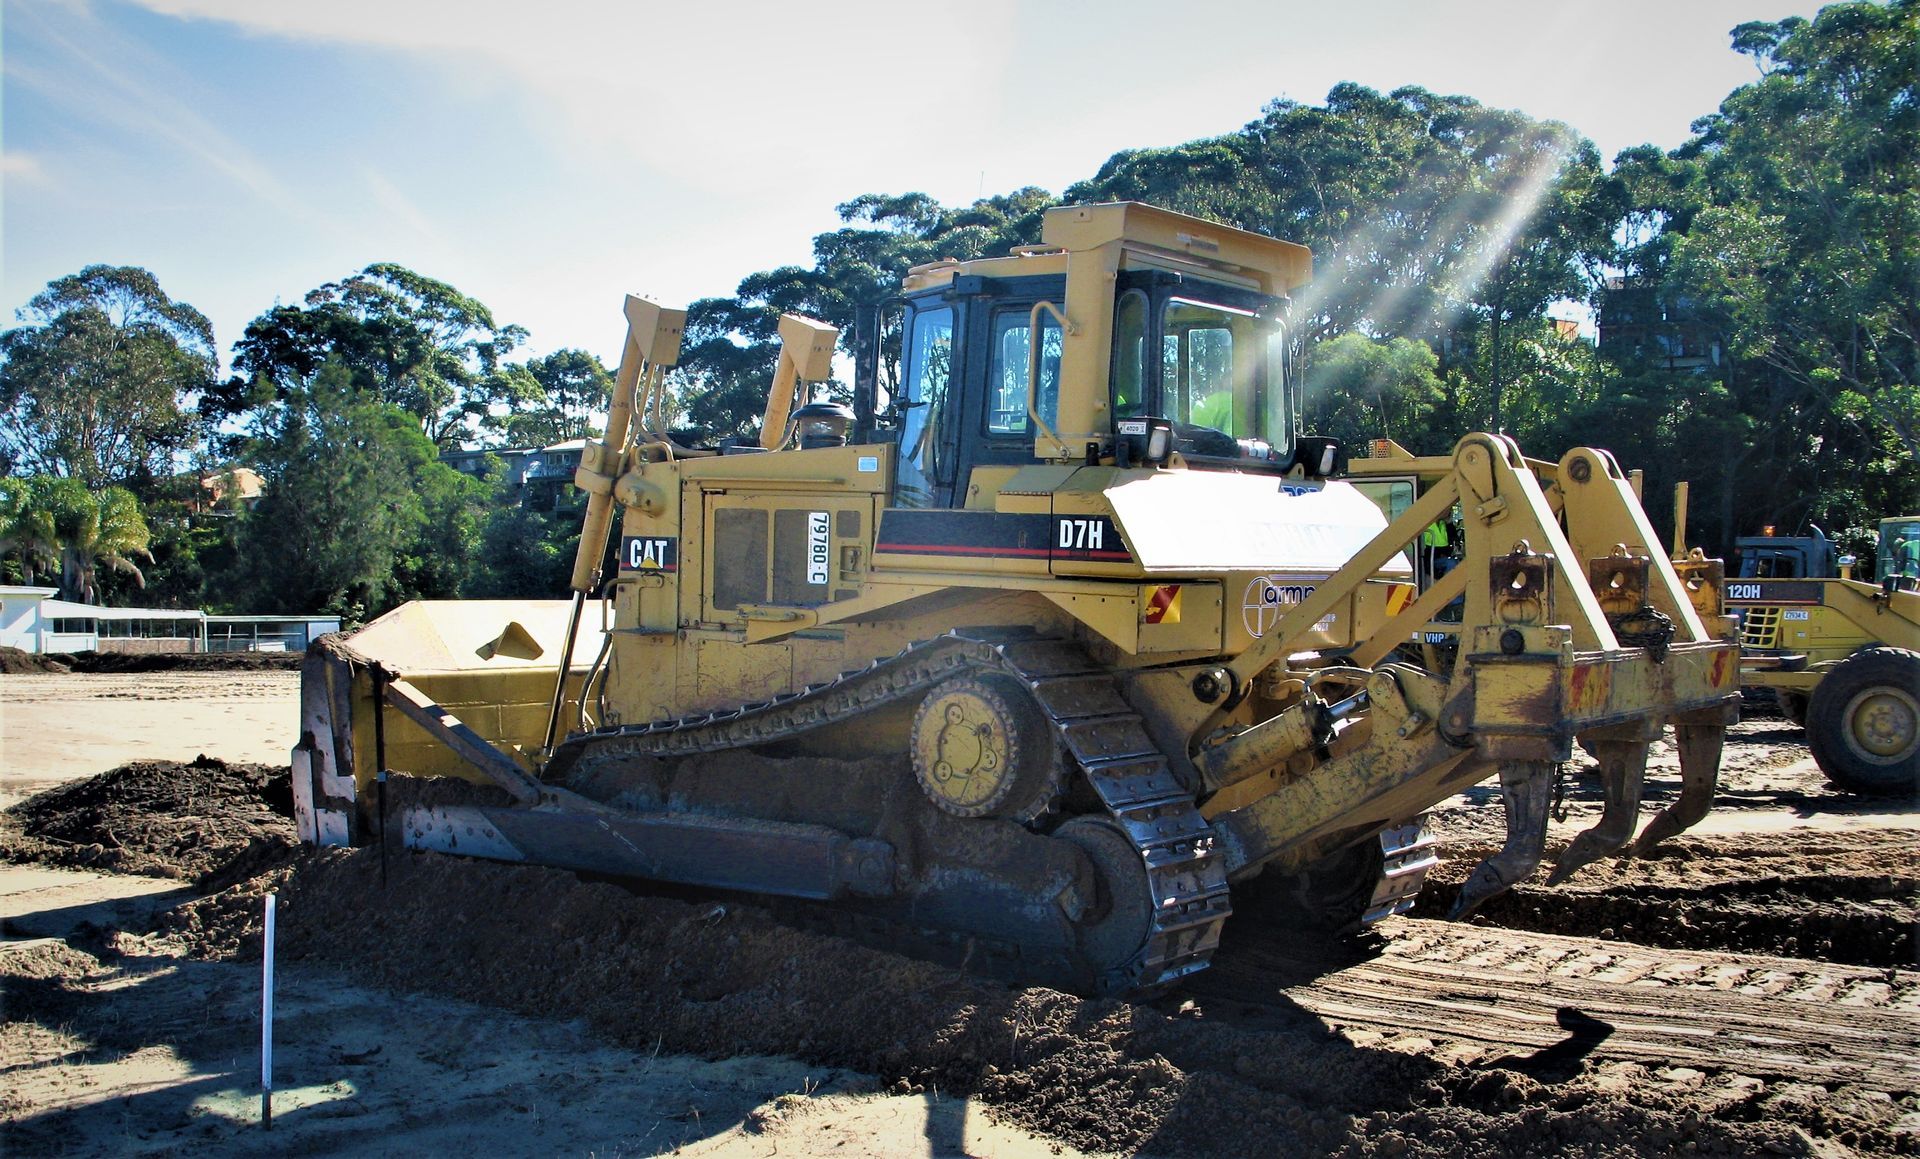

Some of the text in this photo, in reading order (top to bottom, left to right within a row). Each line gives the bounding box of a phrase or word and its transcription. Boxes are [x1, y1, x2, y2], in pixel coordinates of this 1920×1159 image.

[1060, 519, 1103, 549] D7H
[630, 539, 668, 569] CAT
[1727, 584, 1761, 599] 120H
[1425, 632, 1445, 643] VHP
